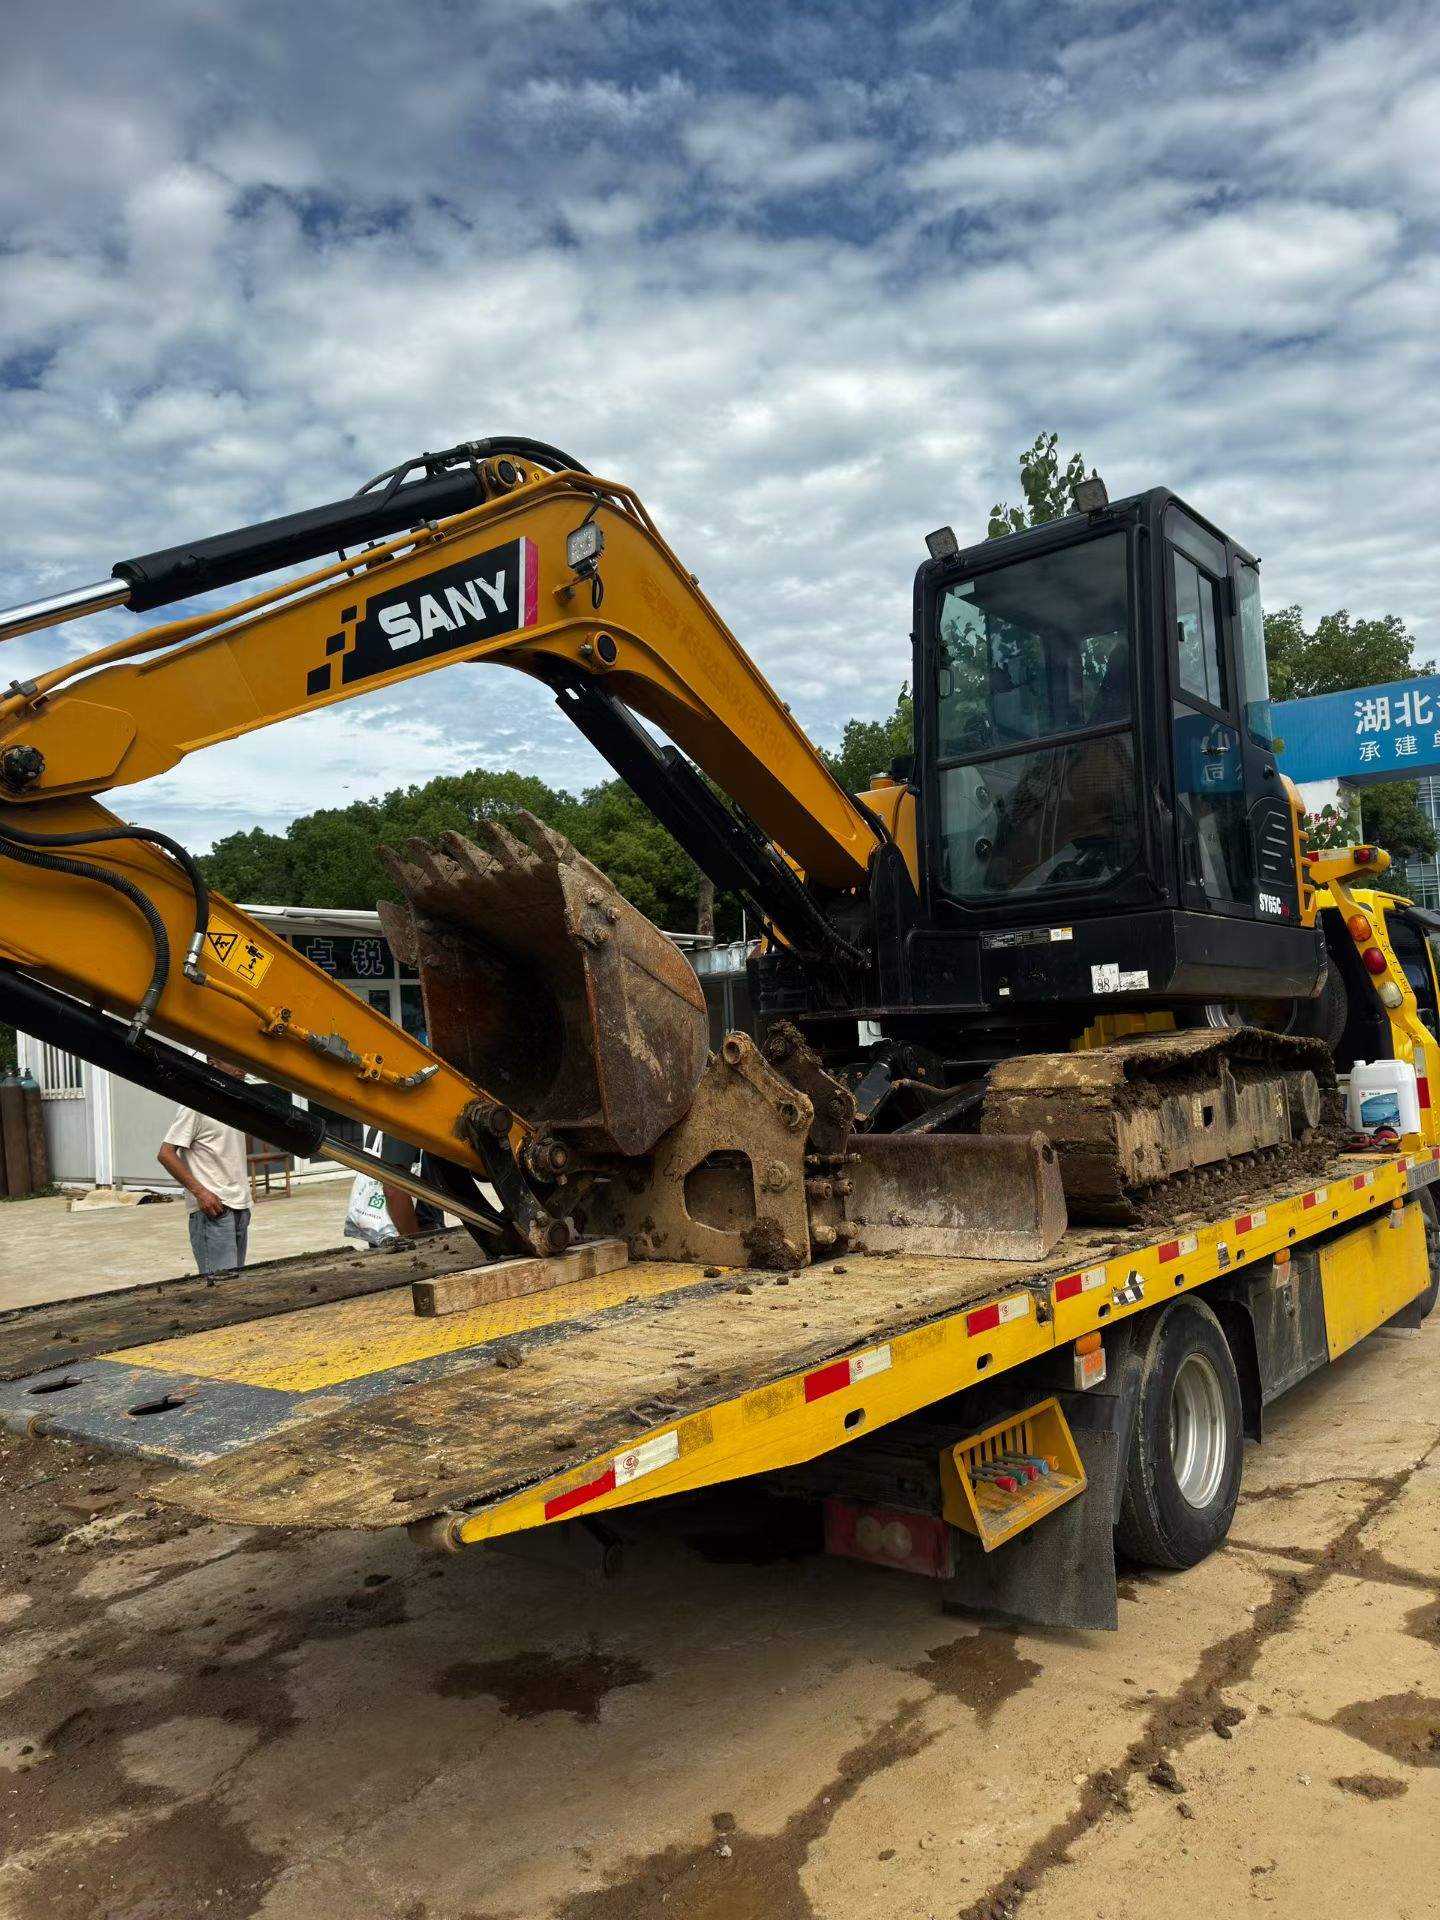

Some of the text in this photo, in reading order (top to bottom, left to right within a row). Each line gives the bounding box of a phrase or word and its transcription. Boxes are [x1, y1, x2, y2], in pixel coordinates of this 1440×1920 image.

[378, 569, 509, 651] SANY
[1354, 690, 1440, 735] 湖北
[306, 937, 385, 976] 卓锐
